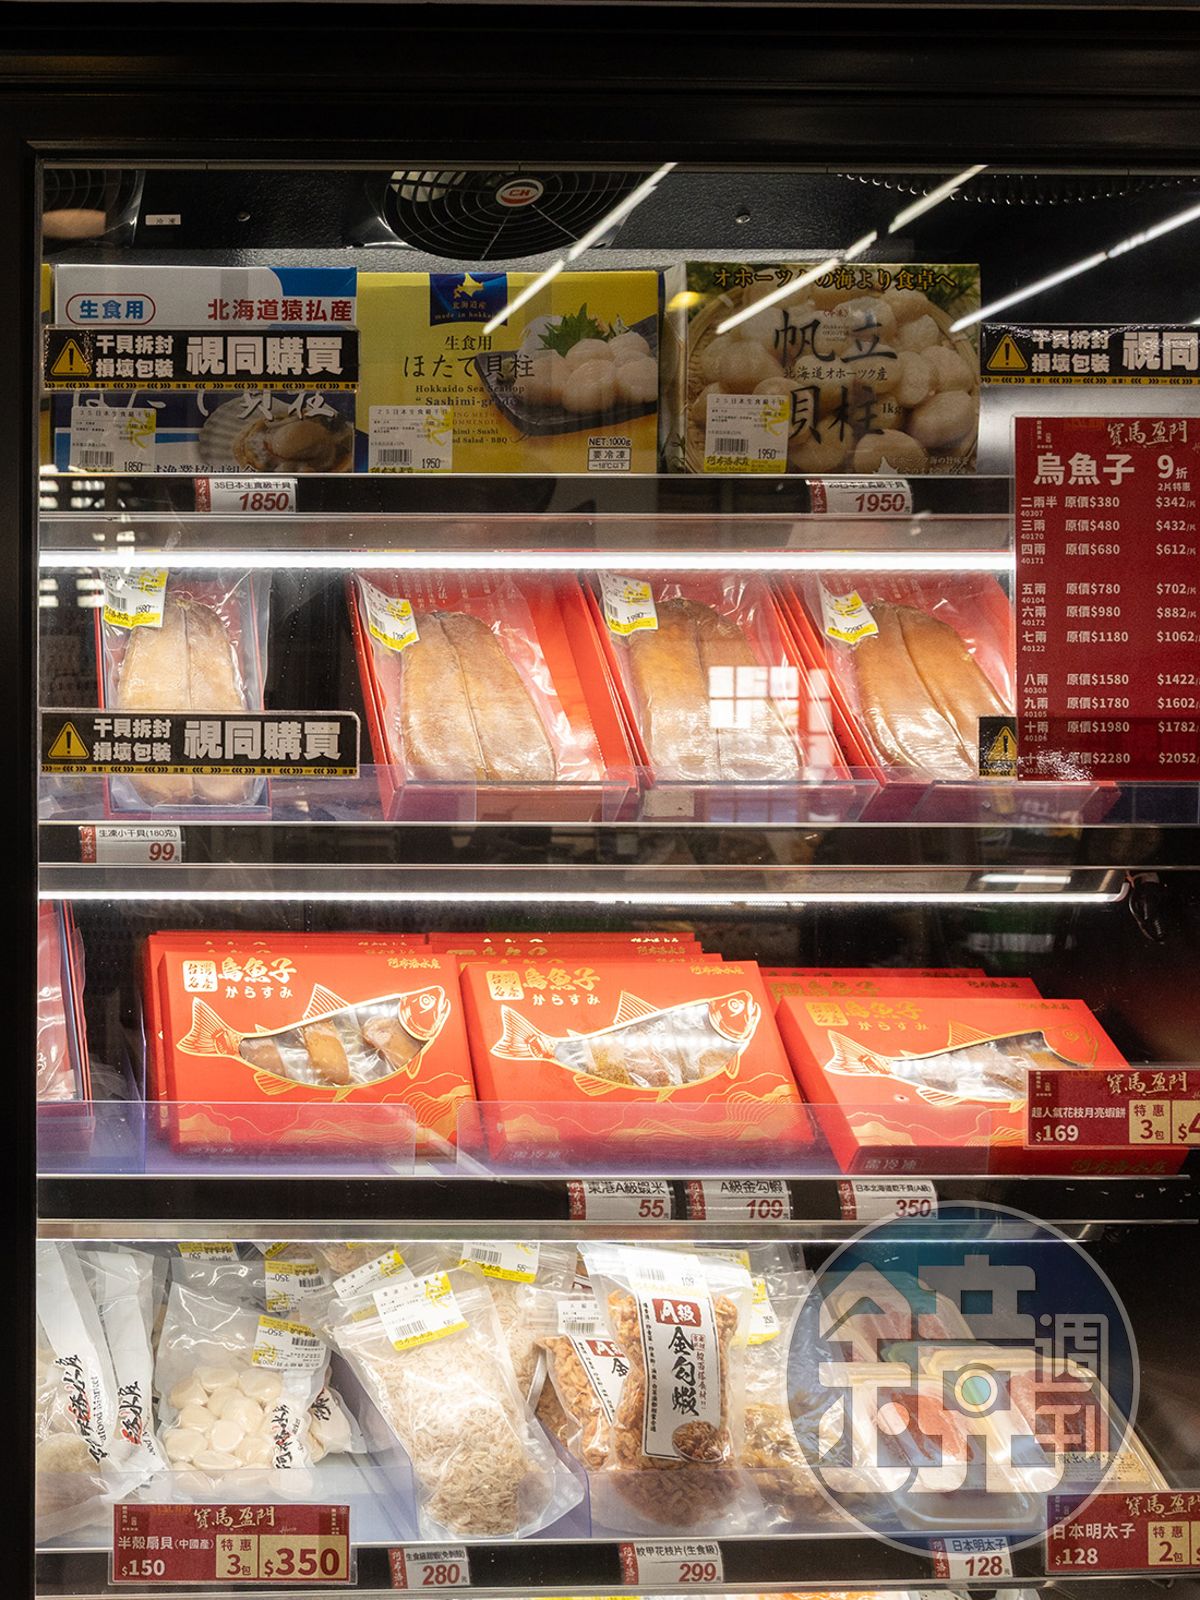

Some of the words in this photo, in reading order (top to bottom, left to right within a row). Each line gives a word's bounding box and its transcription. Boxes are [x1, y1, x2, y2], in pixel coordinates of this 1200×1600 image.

[80, 300, 145, 320] 生食用
[208, 299, 352, 322] 北海道猿払産
[96, 335, 174, 355] 干貝拆封
[445, 335, 492, 351] 生食用
[774, 309, 899, 366] 帆立
[186, 336, 344, 376] 視同購買
[1122, 331, 1199, 371] 視同
[96, 359, 174, 378] 損壞包裝
[404, 355, 535, 379] ほたて貝柱
[1032, 353, 1110, 373] 損壞包裝
[784, 367, 889, 382] 北海道オホーツク産
[416, 385, 464, 393] Hokkaido
[789, 385, 884, 443] 貝柱
[589, 437, 631, 447] NET:1000g
[593, 450, 626, 460] 要冷凍
[1033, 453, 1135, 486] 烏魚子
[239, 492, 290, 512] 1850
[855, 493, 905, 513] 1950
[1021, 496, 1057, 508] 二兩半
[1065, 496, 1120, 509] 原價$380
[1021, 519, 1045, 531] 三兩
[1065, 519, 1120, 532] 原價$480
[1021, 544, 1045, 556] 四兩
[1065, 543, 1120, 556] 原價$680
[1022, 583, 1046, 595] 五兩
[1066, 583, 1121, 596] 原價$780
[1022, 606, 1047, 618] 六兩
[1066, 606, 1121, 618] 原價$980
[1022, 631, 1047, 643] 七兩
[1066, 631, 1129, 643] 原價$1180
[1024, 673, 1048, 686] 八兩
[1067, 673, 1129, 686] 原價$1580
[1024, 697, 1048, 709] 九兩
[1067, 697, 1129, 709] 原價$1780
[93, 718, 172, 739] 干貝拆封
[1025, 721, 1049, 733] 十兩
[1067, 721, 1130, 733] 原價$1980
[184, 720, 341, 760] 視同購買
[93, 742, 172, 762] 損壞包裝
[148, 843, 175, 862] 99
[217, 956, 297, 984] 烏魚子
[523, 967, 601, 990] 烏魚子
[225, 986, 294, 999] からすみ
[532, 994, 601, 1006] からすみ
[844, 1000, 923, 1021] 烏魚子
[858, 1022, 929, 1032] からすみ
[1031, 1106, 1126, 1120] 超人氣花枝月亮蝦餅
[1134, 1103, 1165, 1118] 特惠
[1036, 1123, 1080, 1142] $169
[1140, 1119, 1165, 1141] 3包
[638, 1199, 664, 1217] 55
[746, 1199, 784, 1218] 109
[895, 1199, 931, 1218] 350
[660, 1303, 697, 1324] A級
[668, 1326, 700, 1417] 金勾蝦
[1053, 1523, 1135, 1540] 日本明太子
[1152, 1525, 1184, 1538] 特惠
[221, 1538, 252, 1551] 特惠
[952, 1539, 1005, 1552] 日本明太子
[1159, 1541, 1184, 1563] 2包
[227, 1555, 252, 1576] 3包
[264, 1549, 340, 1576] $350
[1056, 1548, 1099, 1565] $128
[122, 1559, 166, 1577] $150
[422, 1564, 460, 1586] 280
[678, 1562, 717, 1583] 299
[965, 1556, 1004, 1577] 128
